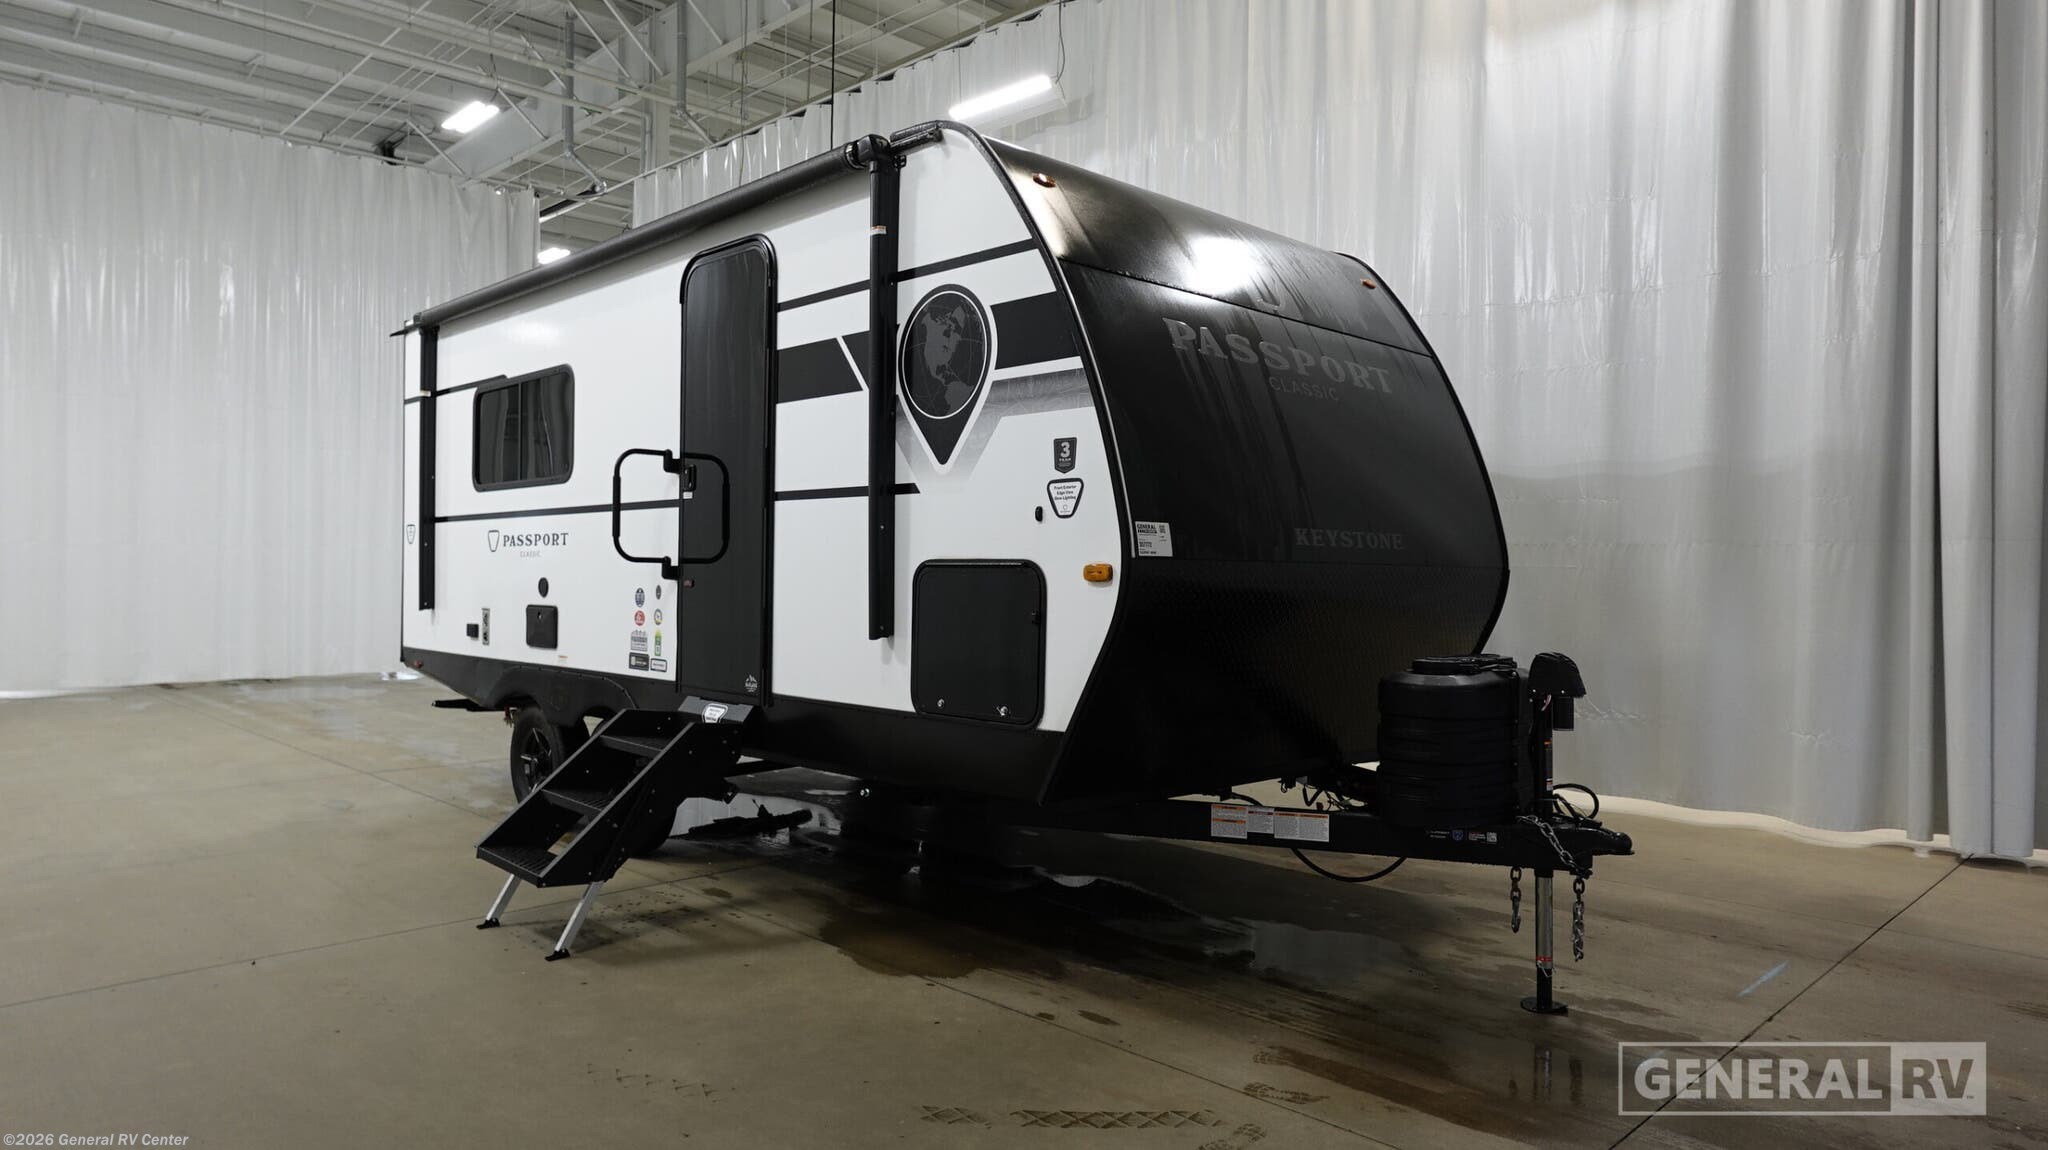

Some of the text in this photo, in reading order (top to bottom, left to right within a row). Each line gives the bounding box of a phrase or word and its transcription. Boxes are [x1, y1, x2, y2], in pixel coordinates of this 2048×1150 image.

[1163, 317, 1393, 394] PASSPORT
[1269, 376, 1339, 401] CLASSIC
[1060, 441, 1070, 458] 3
[503, 532, 569, 548] PASSPORT
[1294, 527, 1405, 550] KEYSTONE
